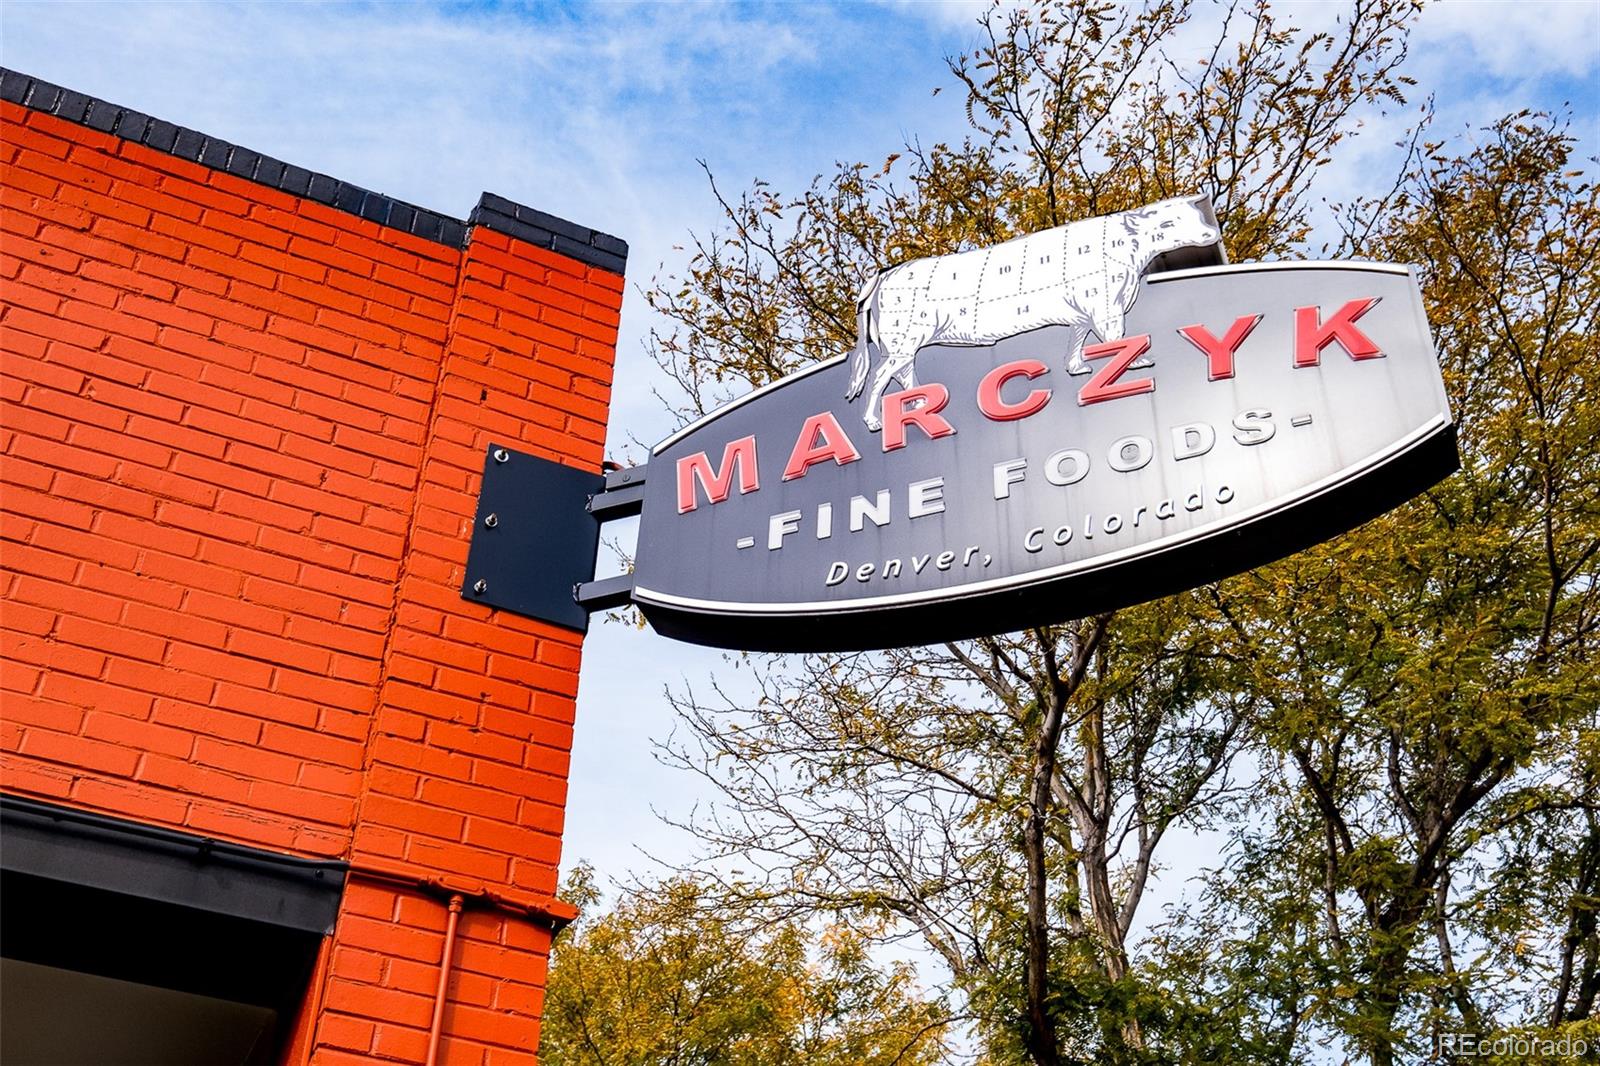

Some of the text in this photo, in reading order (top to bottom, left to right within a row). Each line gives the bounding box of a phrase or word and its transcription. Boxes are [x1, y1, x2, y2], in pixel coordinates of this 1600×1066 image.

[1151, 232, 1165, 243] 18
[1111, 239, 1125, 248] 16
[1078, 245, 1091, 255] 12
[1040, 255, 1050, 264] 11
[999, 265, 1012, 275] 10
[907, 271, 914, 281] 2
[952, 272, 957, 281] 1
[1111, 272, 1125, 283] 15
[1085, 287, 1099, 298] 13
[894, 296, 902, 306] 3
[920, 311, 928, 319] 6
[959, 307, 967, 316] 8
[1017, 305, 1030, 315] 14
[892, 319, 900, 328] 4
[1105, 319, 1118, 331] 17
[891, 338, 898, 348] 5
[910, 337, 917, 346] 7
[889, 359, 897, 367] 9
[676, 296, 1387, 515] MARCZYK
[825, 481, 1236, 586] Denver, Colorado
